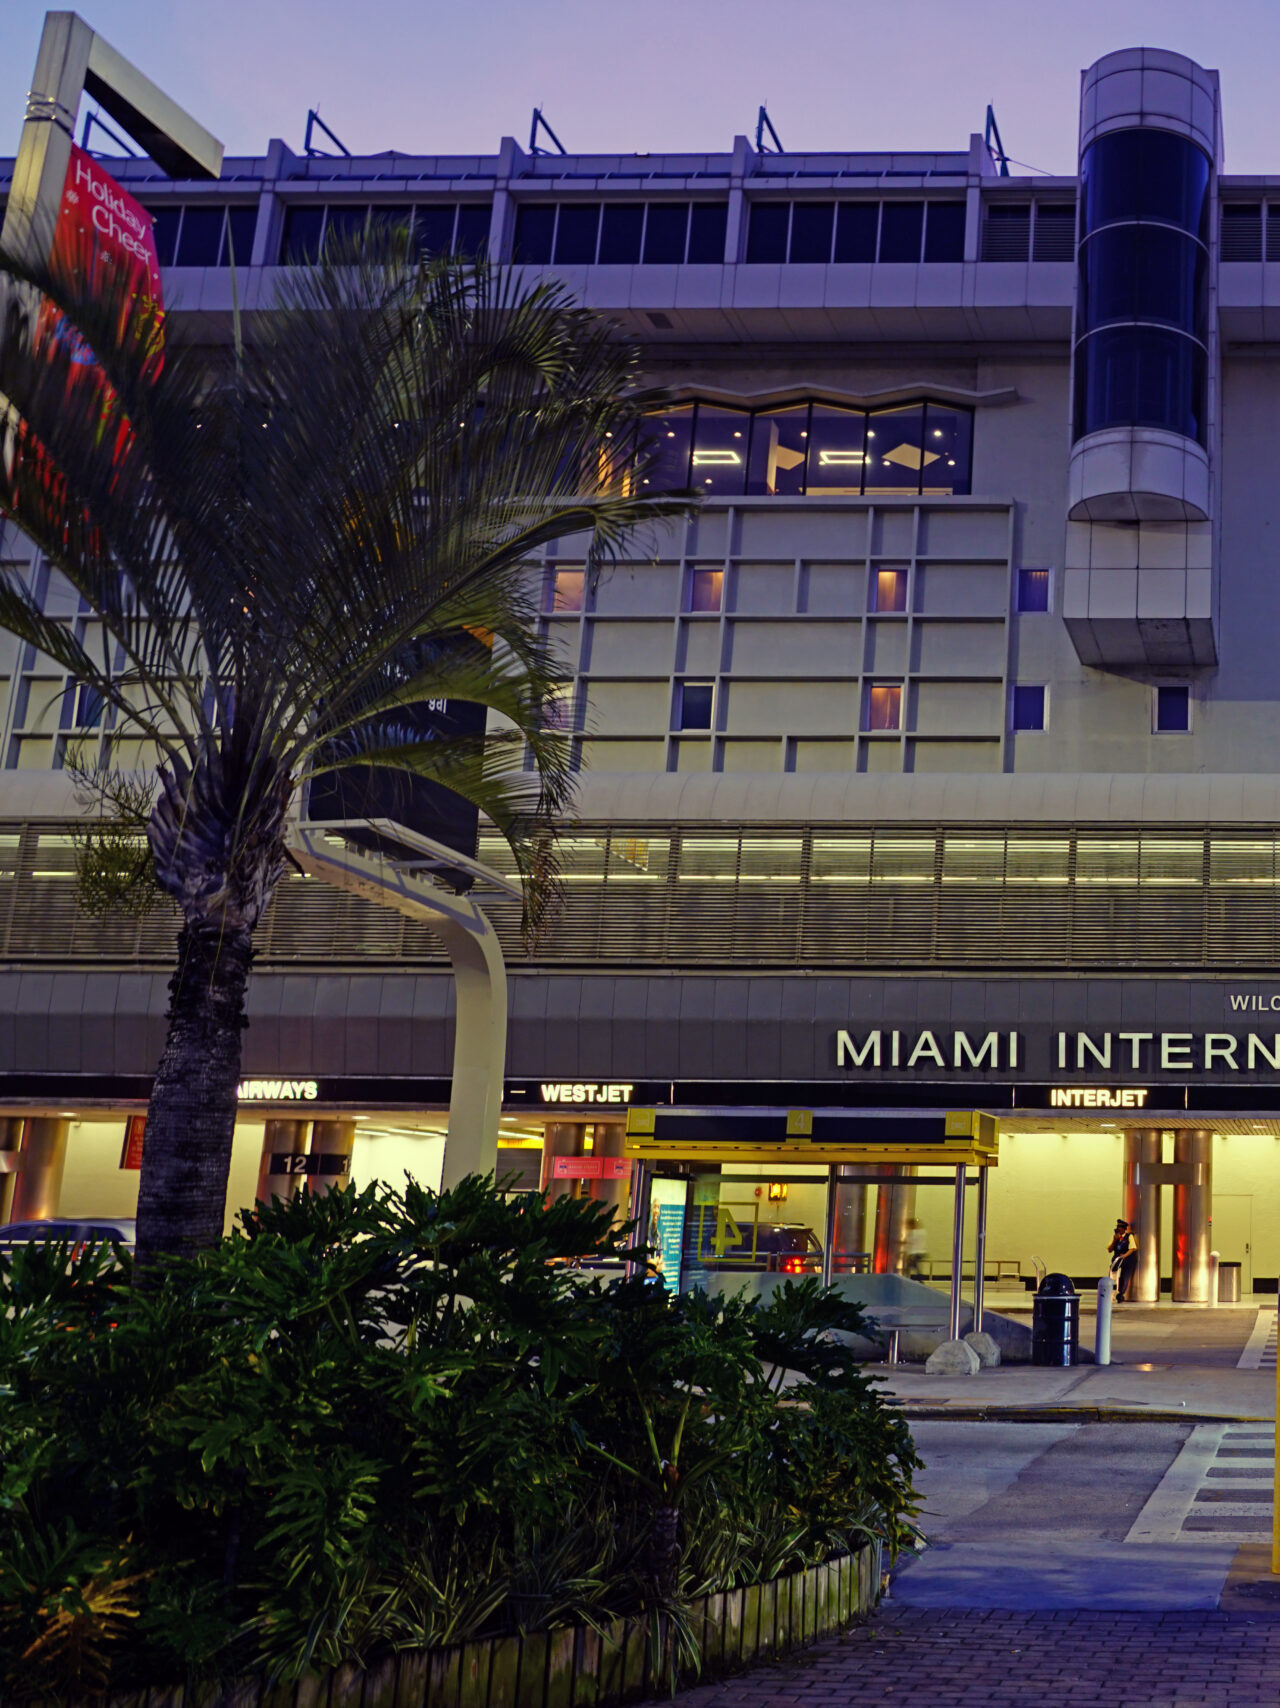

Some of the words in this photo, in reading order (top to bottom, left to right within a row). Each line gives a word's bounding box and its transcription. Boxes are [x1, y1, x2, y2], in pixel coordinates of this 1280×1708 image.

[75, 159, 147, 240] Holiday
[91, 204, 153, 265] Cheer
[836, 1030, 1019, 1069] MIAMI
[541, 1084, 633, 1103] WESTJET
[1050, 1088, 1148, 1108] INTERJET
[793, 1112, 805, 1130] 4
[283, 1156, 307, 1174] 12
